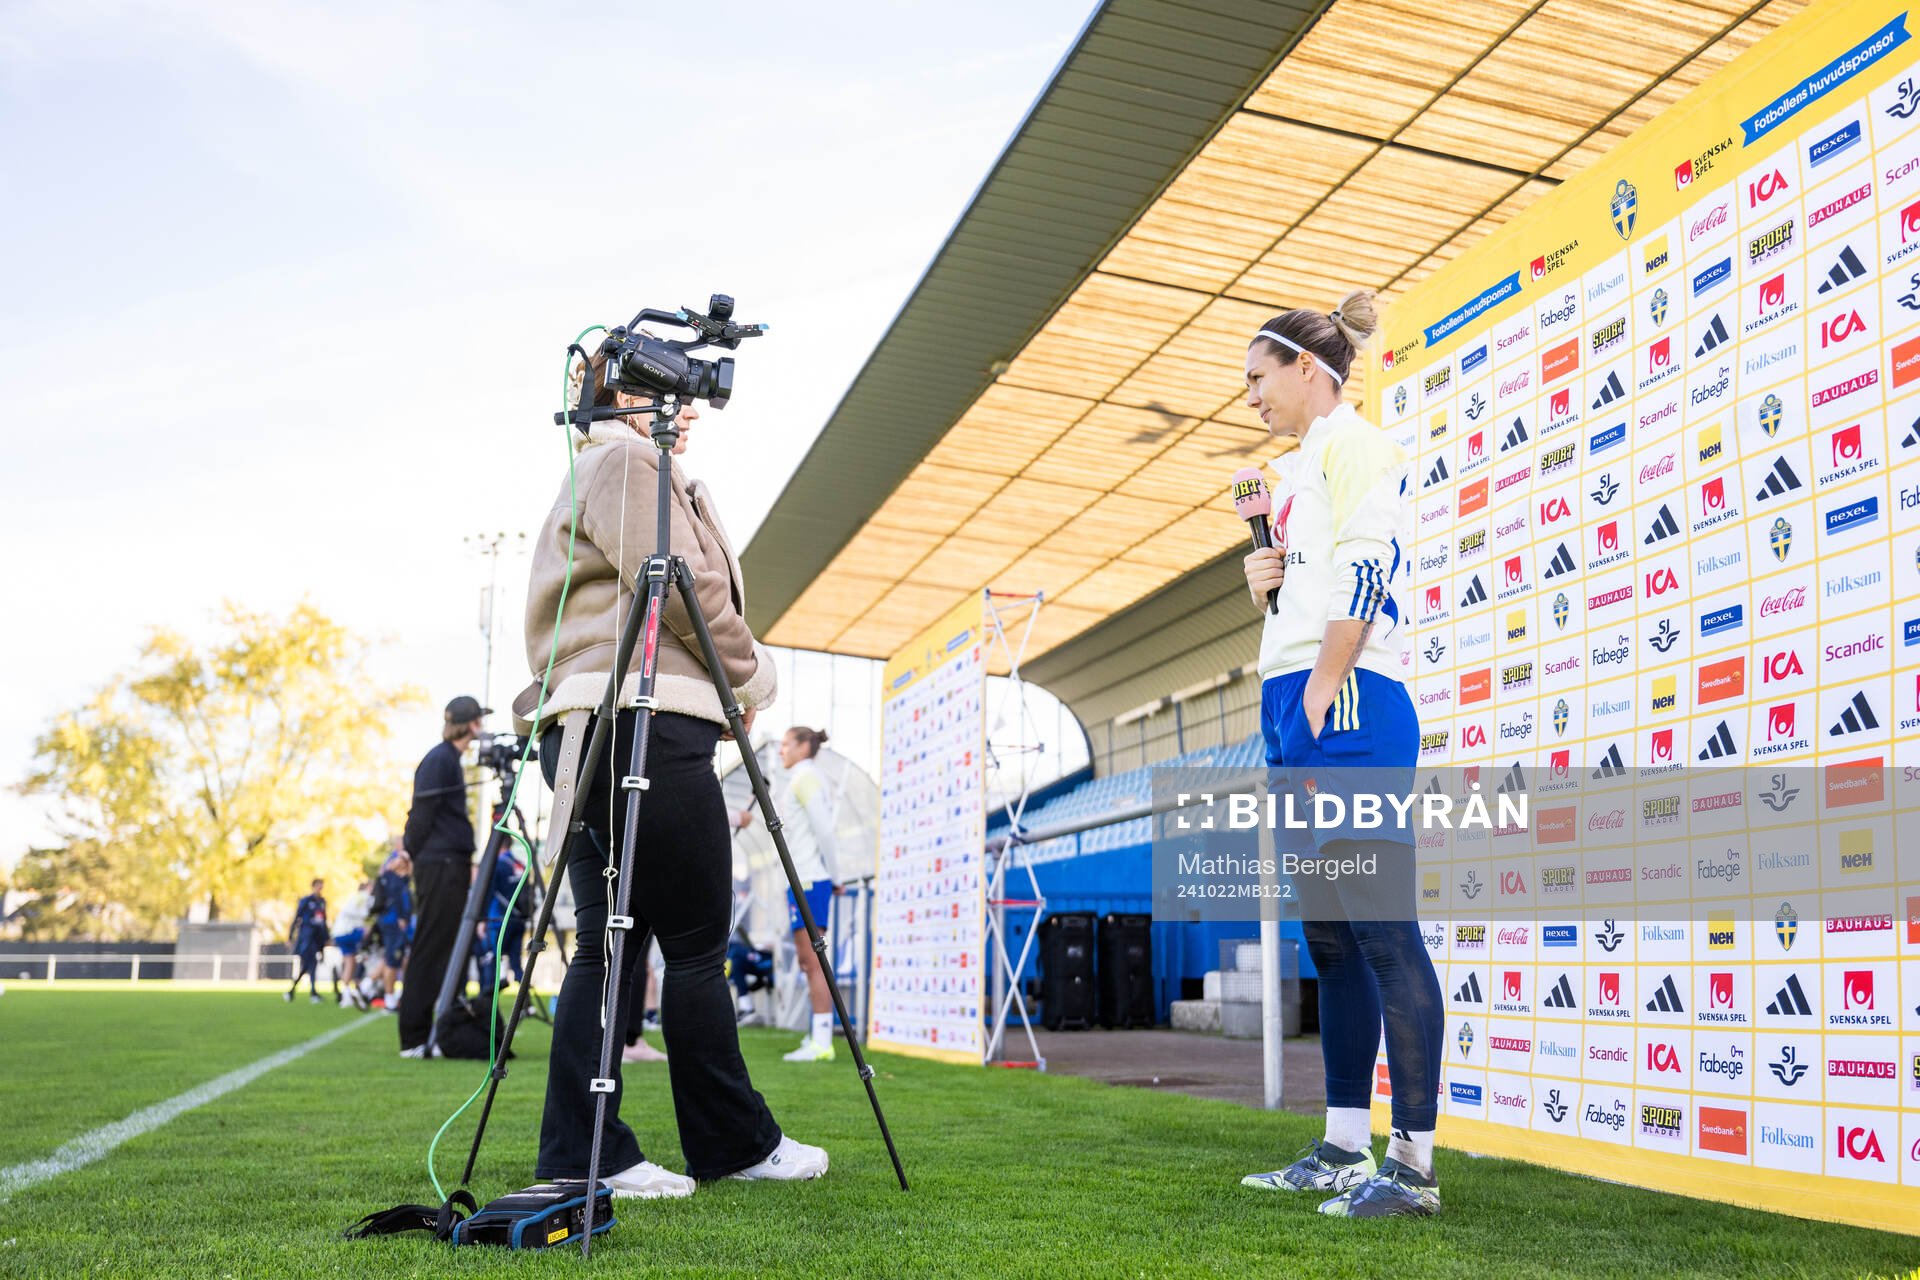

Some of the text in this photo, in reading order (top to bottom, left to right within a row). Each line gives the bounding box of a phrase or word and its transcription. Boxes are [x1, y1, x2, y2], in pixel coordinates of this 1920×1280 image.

[1754, 31, 1894, 133] Fotbollens huvudsponsor
[1898, 78, 1913, 100] SJ
[1694, 138, 1733, 169] SVENSKA
[1695, 160, 1714, 179] SPEL
[1750, 168, 1789, 208] ICA
[1808, 184, 1871, 227] BAUHAUS
[1749, 220, 1793, 259] SPORT
[1547, 240, 1578, 263] SVENSKA
[1751, 240, 1793, 265] BLADET
[1547, 259, 1565, 273] SPEL
[1588, 273, 1624, 301] Folksam
[1432, 282, 1512, 339] Fotbollens huvudsponsor
[1541, 304, 1576, 329] Fabege
[1745, 303, 1799, 333] SVENSKA SPEL
[1592, 317, 1625, 349] SPORT
[1822, 308, 1867, 349] ICA
[1395, 339, 1419, 357] SVENSKA
[1497, 326, 1530, 351] Scandic
[1395, 353, 1409, 366] SPEL
[1746, 343, 1797, 375] Folksam
[643, 363, 666, 378] SONY
[1425, 366, 1450, 392] SPORT
[1639, 365, 1681, 390] SVENSKA SPEL
[1691, 376, 1729, 407] Fabege
[1812, 370, 1878, 407] BAUHAUS
[1639, 401, 1678, 429] Scandic
[1541, 415, 1579, 435] SVENSKA SPEL
[1541, 443, 1575, 470] SPORT
[1495, 467, 1531, 492] BAUHAUS
[1600, 473, 1610, 489] SJ
[1819, 458, 1879, 485] SVENSKA SPEL
[1421, 505, 1449, 523] Scandic
[1541, 496, 1571, 525] ICA
[1496, 517, 1525, 538] Scandic
[1693, 508, 1739, 533] SVENSKA SPEL
[1459, 529, 1485, 553] SPORT
[1420, 553, 1448, 571] Fabege
[1589, 551, 1629, 570] SVENSKA SPEL
[1697, 551, 1741, 576] Folksam
[1646, 566, 1679, 598] ICA
[1826, 571, 1881, 597] Folksam
[1497, 584, 1532, 600] SVENSKA SPEL
[1588, 586, 1632, 610] BAUHAUS
[1658, 618, 1670, 635] SJ
[1430, 636, 1439, 648] SJ
[1825, 633, 1884, 661] Scandic
[1545, 656, 1580, 675] Scandic
[1593, 647, 1629, 666] Fabege
[1763, 649, 1804, 683] ICA
[1502, 663, 1532, 685] SPORT
[1701, 675, 1732, 690] Swedbank
[1419, 688, 1451, 705] Scandic
[1592, 700, 1630, 718] Folksam
[1462, 723, 1486, 748] ICA
[1500, 721, 1532, 739] Fabege
[1421, 731, 1448, 750] SPORT
[1753, 739, 1809, 756] SVENSKA SPEL
[1640, 763, 1684, 777] SVENSKA SPEL
[1538, 781, 1578, 792] SVENSKA SPEL
[1772, 774, 1786, 791] SJ
[1829, 777, 1868, 791] Swedbank
[1643, 795, 1680, 819] SPORT
[1692, 792, 1741, 813] BAUHAUS
[1645, 815, 1679, 825] BLADET
[1698, 860, 1740, 882] Fabege
[1758, 853, 1810, 871] Folksam
[1468, 871, 1475, 883] SJ
[1542, 867, 1575, 886] SPORT
[1586, 868, 1632, 884] BAUHAUS
[1641, 864, 1682, 881] Scandic
[1500, 871, 1526, 895] ICA
[1544, 885, 1574, 893] BLADET
[1604, 919, 1614, 934] SJ
[1642, 925, 1684, 941] Folksam
[1826, 914, 1892, 933] BAUHAUS
[1456, 925, 1485, 942] SPORT
[1494, 1003, 1517, 1012] SVENSKA
[1589, 1009, 1630, 1018] SVENSKA SPEL
[1698, 1013, 1747, 1022] SVENSKA SPEL
[1829, 1015, 1892, 1025] SVENSKA SPEL
[1489, 1037, 1531, 1052] BAUHAUS
[1540, 1040, 1576, 1058] Folksam
[1589, 1046, 1628, 1062] Scandic
[1647, 1043, 1682, 1073] ICA
[1782, 1046, 1796, 1064] SJ
[1699, 1052, 1743, 1080] Fabege
[1828, 1060, 1896, 1079] BAUHAUS
[1493, 1091, 1527, 1109] Scandic
[1550, 1089, 1561, 1105] SJ
[1585, 1104, 1625, 1131] Fabege
[1642, 1105, 1681, 1130] SPORT
[1643, 1126, 1680, 1138] BLADET
[1701, 1124, 1735, 1136] Swedbank
[1761, 1125, 1814, 1148] Folksam
[1838, 1126, 1885, 1163] ICA
